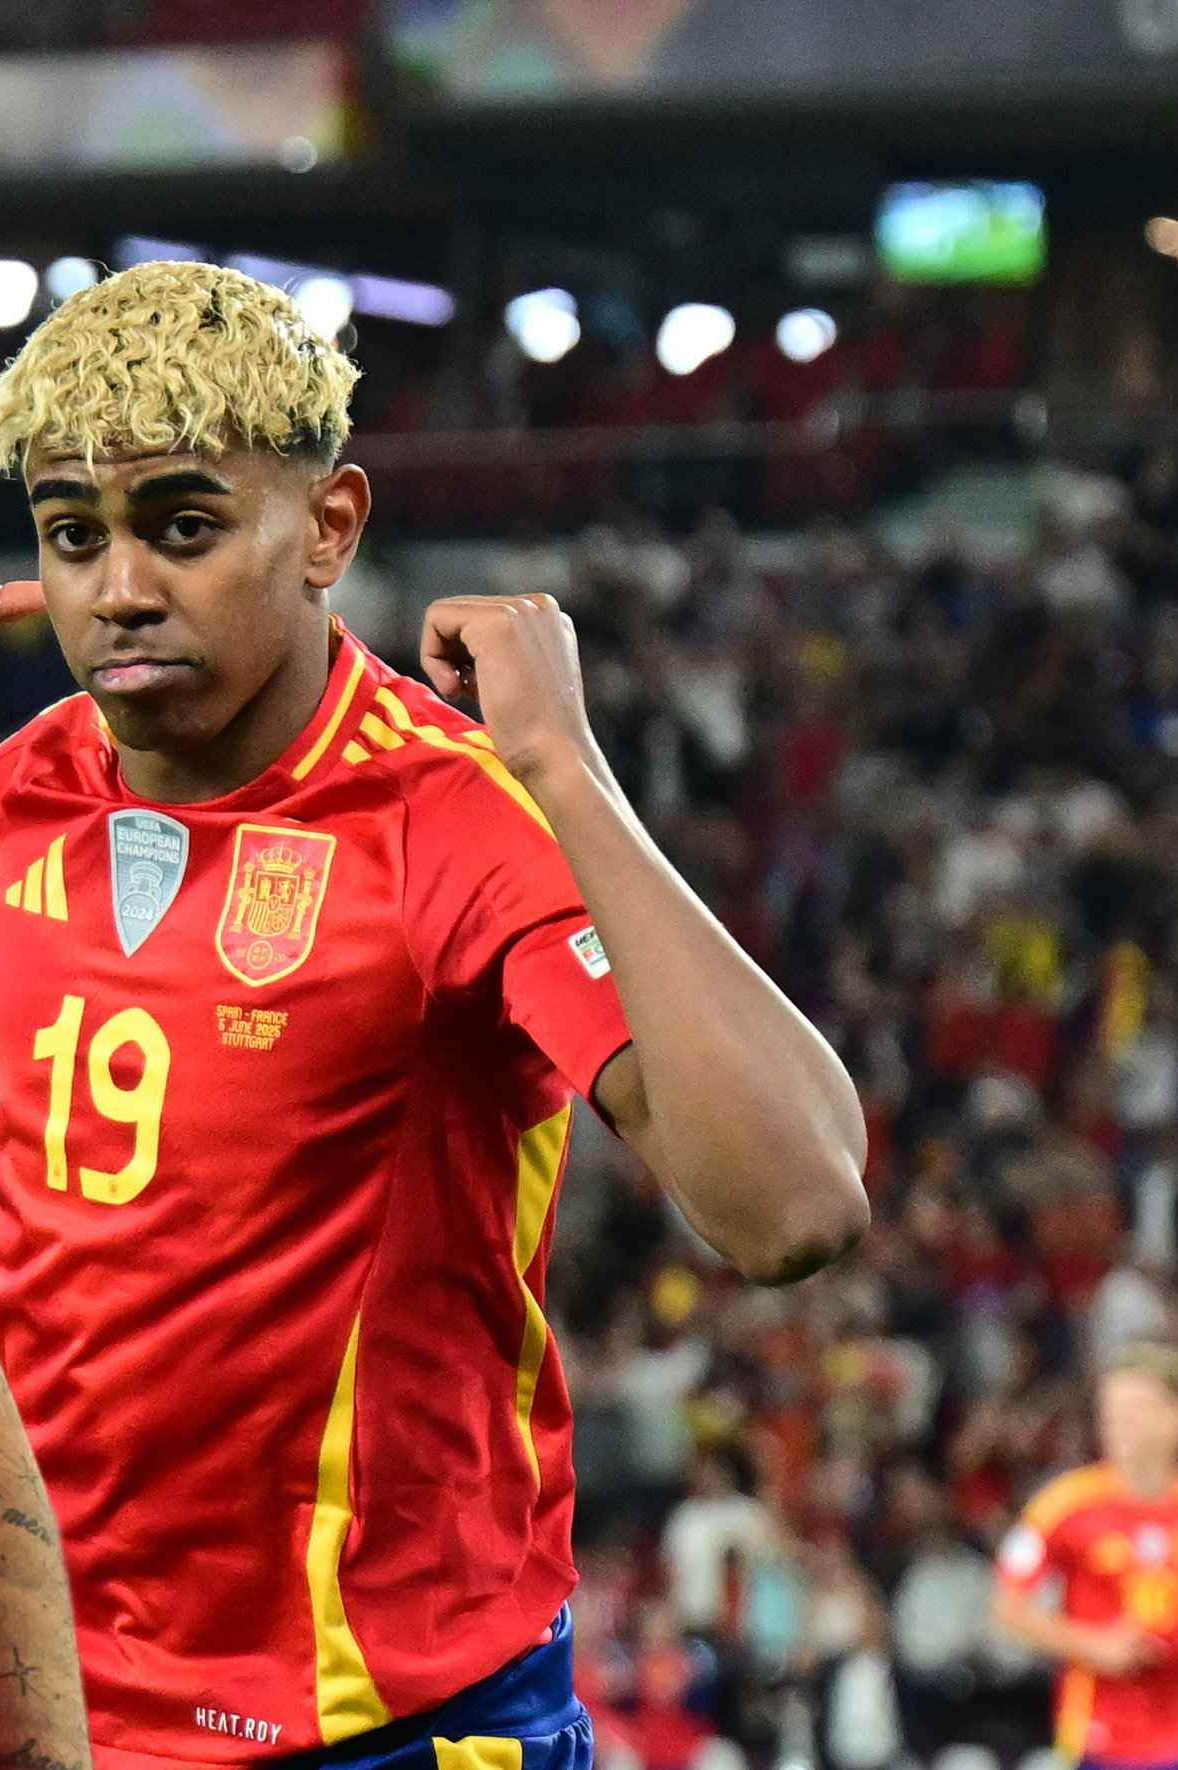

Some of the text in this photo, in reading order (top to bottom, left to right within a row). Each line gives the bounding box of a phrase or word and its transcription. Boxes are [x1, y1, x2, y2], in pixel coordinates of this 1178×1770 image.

[135, 816, 161, 832] UEFA
[117, 826, 180, 850] EUROPEAN
[117, 842, 180, 864] CHAMPIONS
[123, 904, 153, 921] 2024
[216, 1004, 243, 1020] SPAIN
[251, 1009, 289, 1026] FRANCE
[228, 1020, 253, 1034] JUNE
[255, 1023, 281, 1038] 2025
[222, 1032, 275, 1051] STUTTGART
[33, 994, 171, 1205] 19
